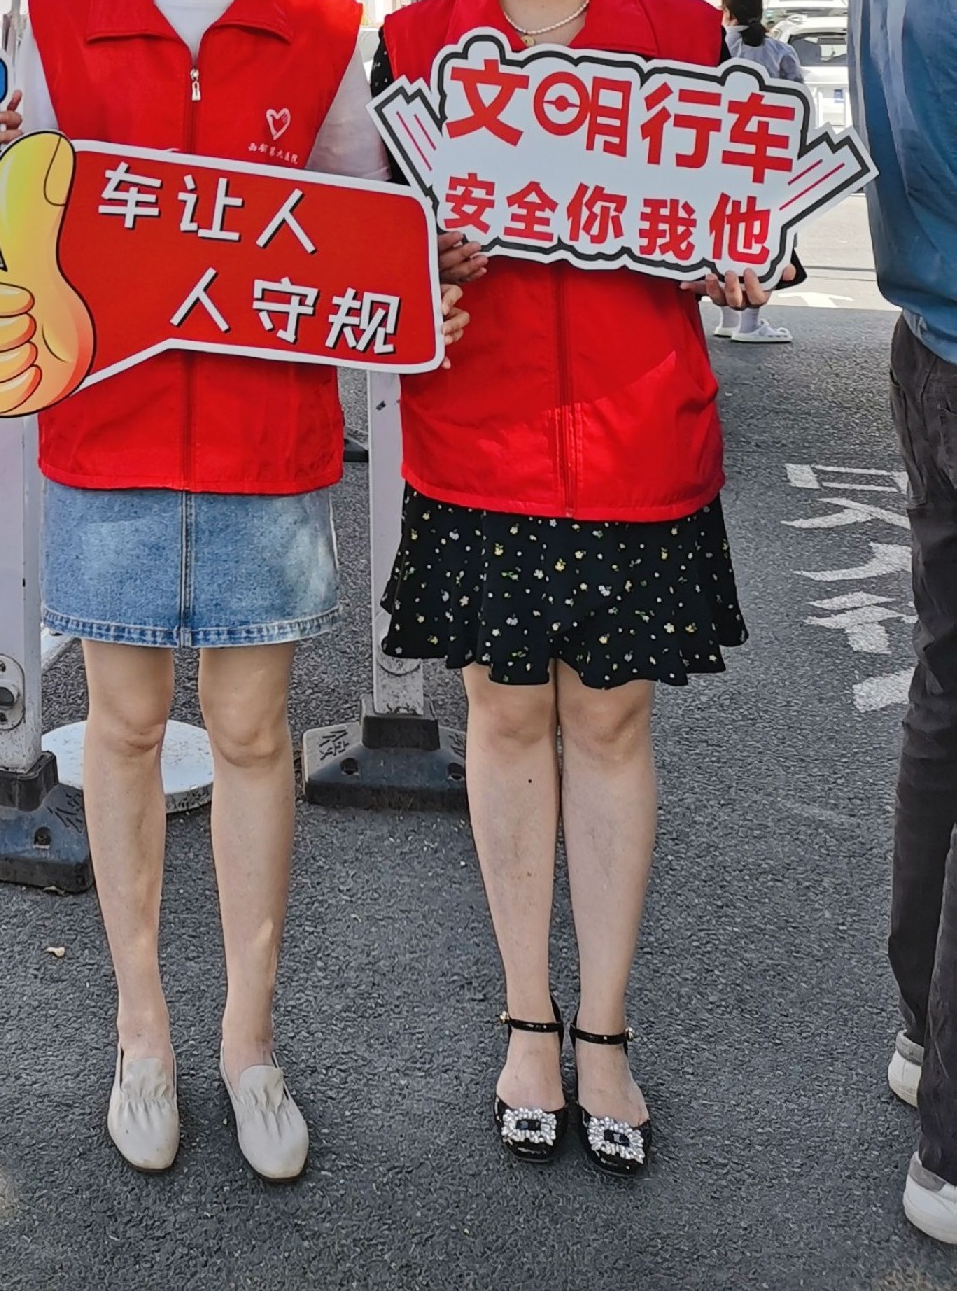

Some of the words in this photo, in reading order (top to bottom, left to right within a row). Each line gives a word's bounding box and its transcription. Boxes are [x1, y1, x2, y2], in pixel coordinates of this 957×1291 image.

[446, 58, 796, 185] 文明行车
[98, 162, 317, 254] 车让人
[444, 172, 771, 264] 安全你我他
[170, 267, 401, 355] 人守规
